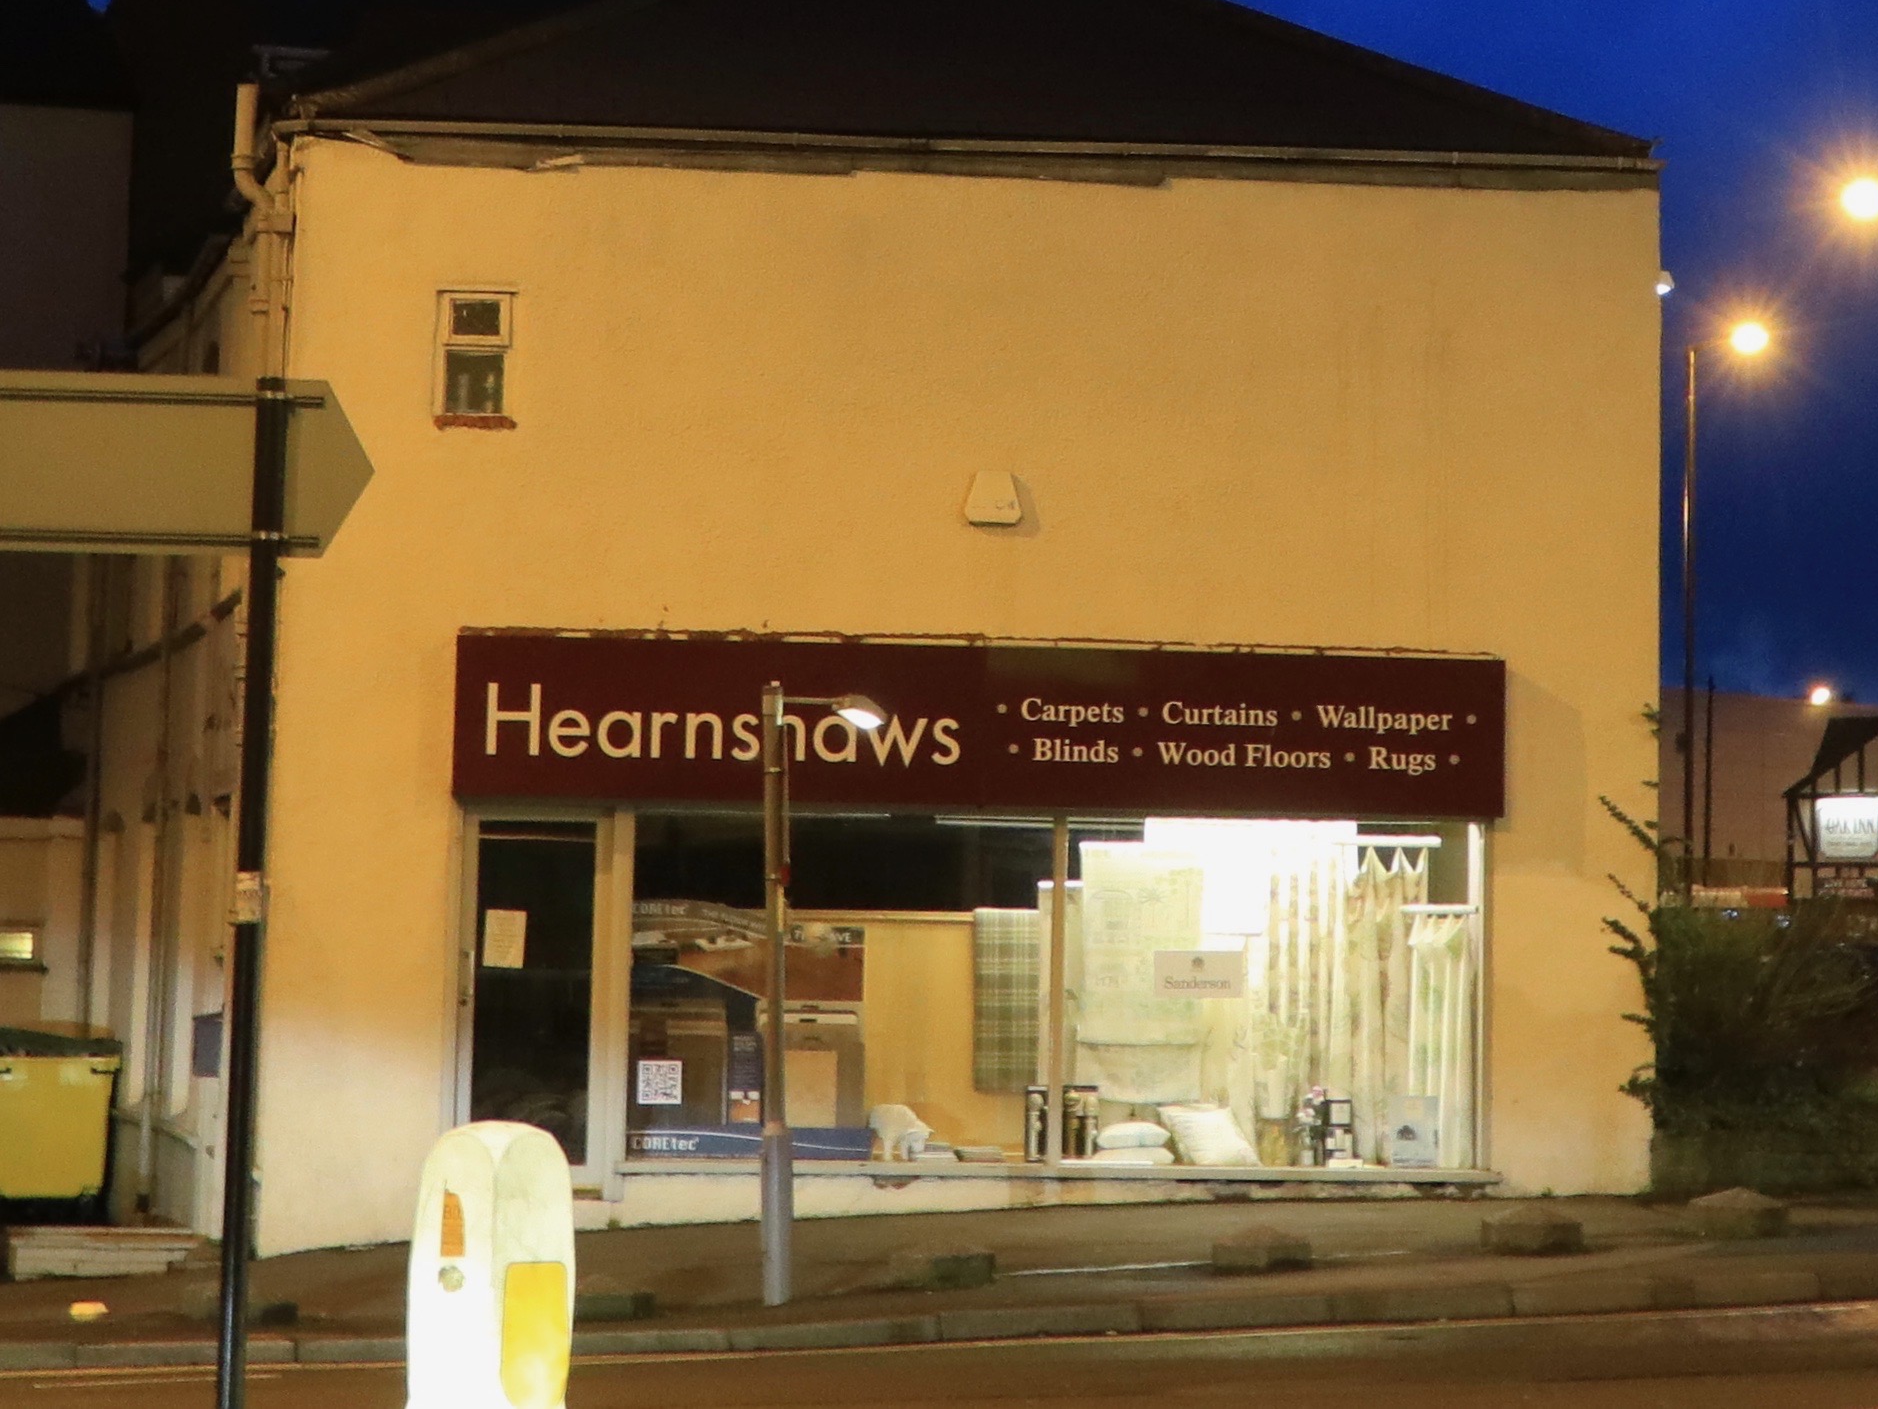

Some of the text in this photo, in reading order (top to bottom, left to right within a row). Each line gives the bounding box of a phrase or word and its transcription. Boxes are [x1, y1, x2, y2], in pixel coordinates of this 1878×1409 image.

[1020, 697, 1454, 735] Carpets Curtains Wallpaper
[1032, 737, 1437, 776] Blinds Wood Floors Rugs
[1164, 975, 1232, 990] Sanderson
